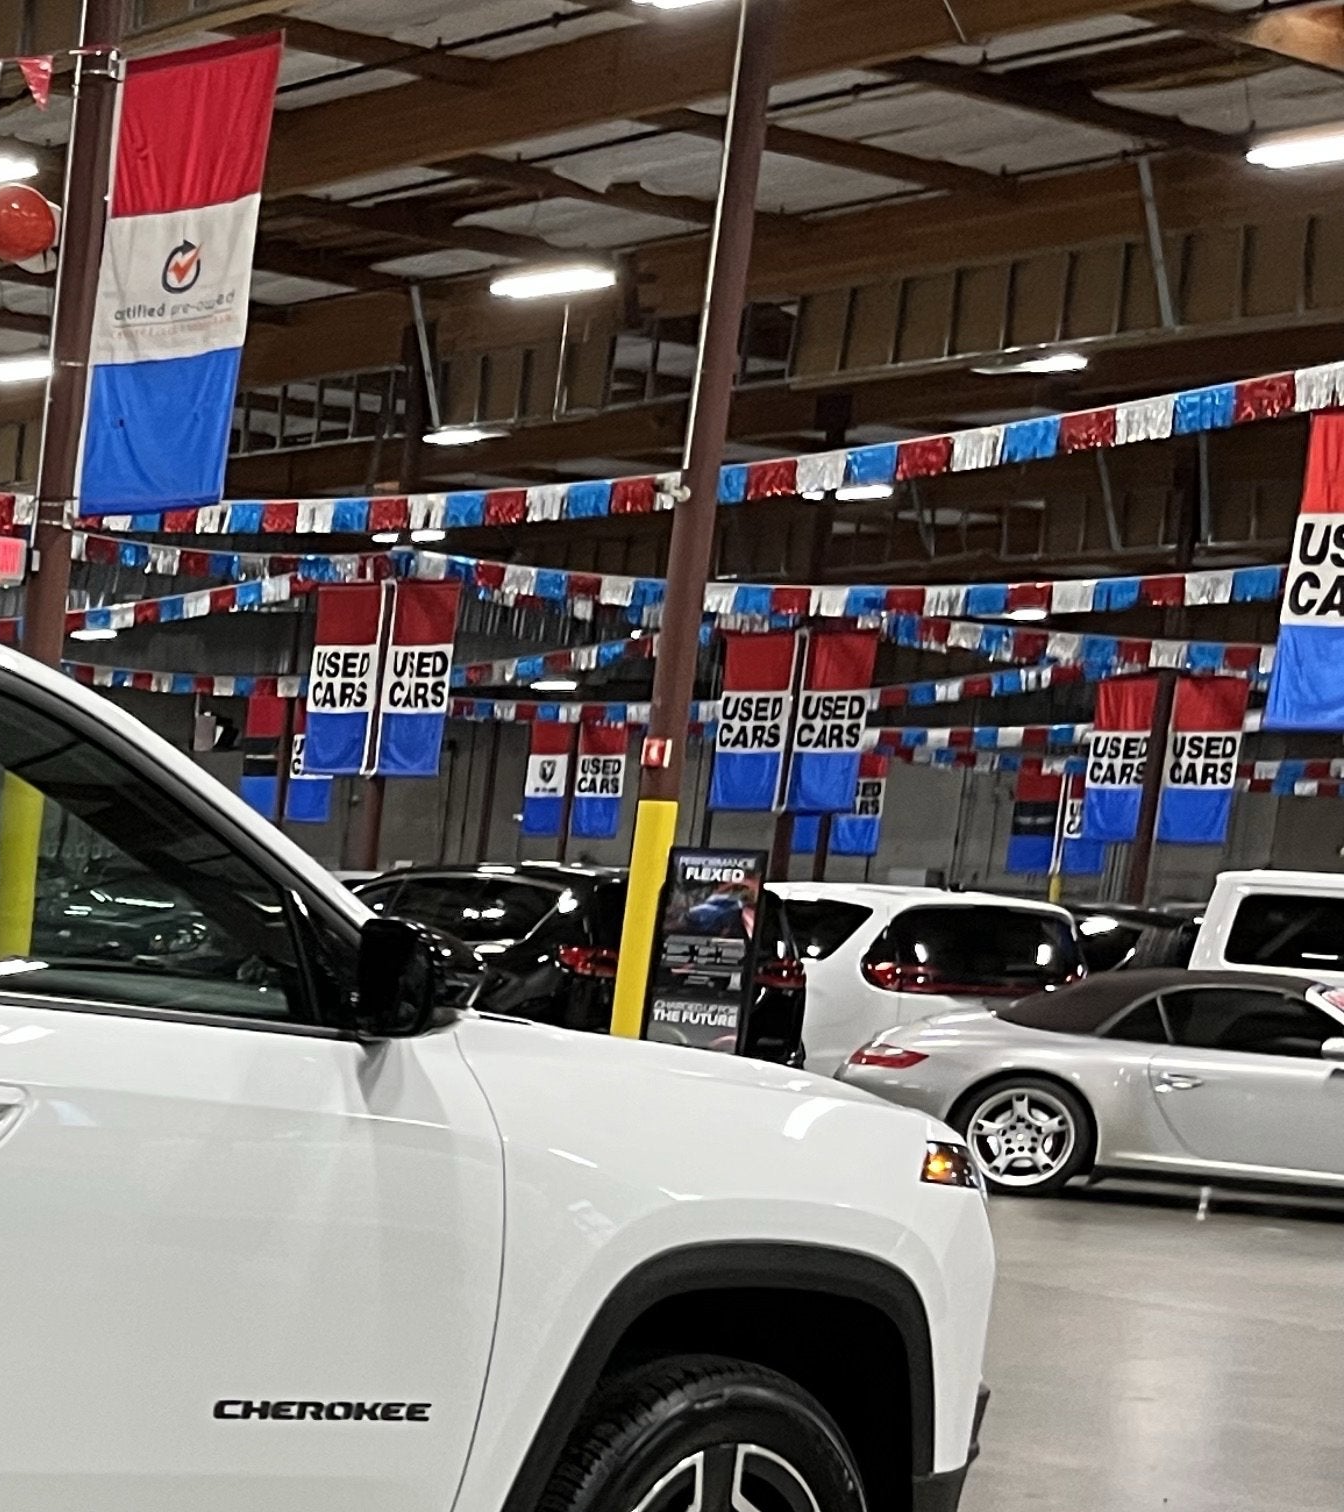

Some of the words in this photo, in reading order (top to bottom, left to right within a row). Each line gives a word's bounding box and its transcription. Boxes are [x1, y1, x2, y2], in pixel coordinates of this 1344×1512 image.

[1299, 522, 1344, 568] US
[1288, 571, 1344, 617] CA
[316, 651, 370, 679] USED
[393, 650, 449, 679] USED
[312, 681, 368, 708] CARS
[388, 681, 446, 708] CARS
[722, 696, 783, 722] USED
[801, 695, 866, 721] USED
[718, 723, 781, 748] CARS
[796, 722, 861, 748] CARS
[1092, 736, 1148, 759] USED
[1172, 736, 1237, 759] USED
[580, 757, 622, 775] USED
[1089, 762, 1146, 784] CARS
[1169, 762, 1233, 785] CARS
[577, 777, 620, 794] CARS
[856, 781, 882, 798] ED
[858, 799, 880, 815] RS
[685, 866, 745, 884] FLEXED
[653, 1008, 680, 1023] THE
[682, 1010, 738, 1028] FUTURE
[212, 1399, 432, 1421] CHEROKEE
